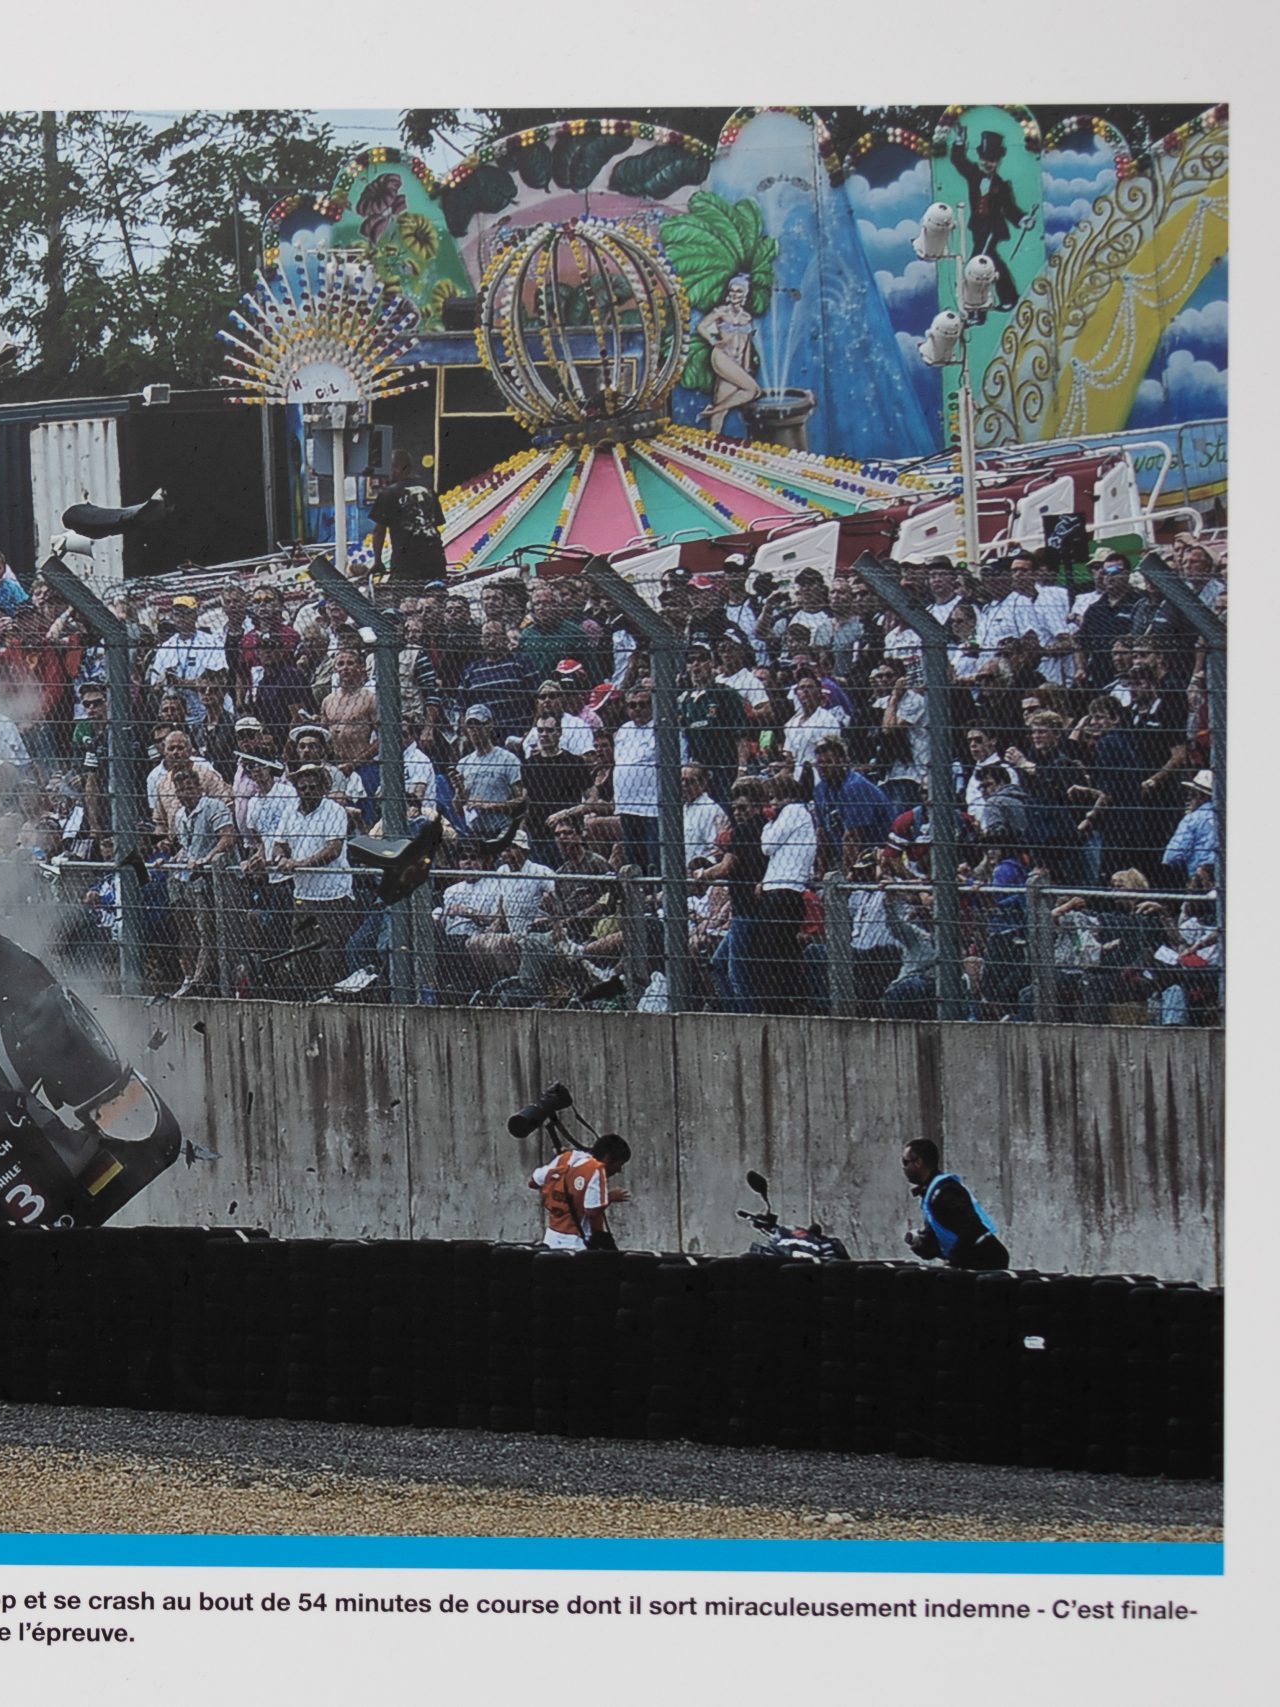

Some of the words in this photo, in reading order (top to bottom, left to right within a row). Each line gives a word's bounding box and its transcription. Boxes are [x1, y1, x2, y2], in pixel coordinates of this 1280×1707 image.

[4, 1183, 46, 1224] 3
[23, 1591, 47, 1610] et
[53, 1595, 81, 1610] se
[88, 1591, 155, 1611] crash
[162, 1595, 191, 1611] au
[199, 1591, 254, 1612] bout
[260, 1592, 291, 1612] de
[298, 1592, 328, 1612] 54
[335, 1593, 432, 1613] minutes
[439, 1593, 469, 1614] de
[476, 1598, 560, 1615] course
[566, 1595, 622, 1615] dont
[629, 1595, 642, 1615] il
[649, 1597, 698, 1616] sort
[705, 1596, 917, 1618] miraculeusement
[924, 1598, 1031, 1619] indemne
[1052, 1599, 1115, 1620] C’est
[1121, 1600, 1198, 1620] finale-
[19, 1621, 135, 1646] l’épreuve.
